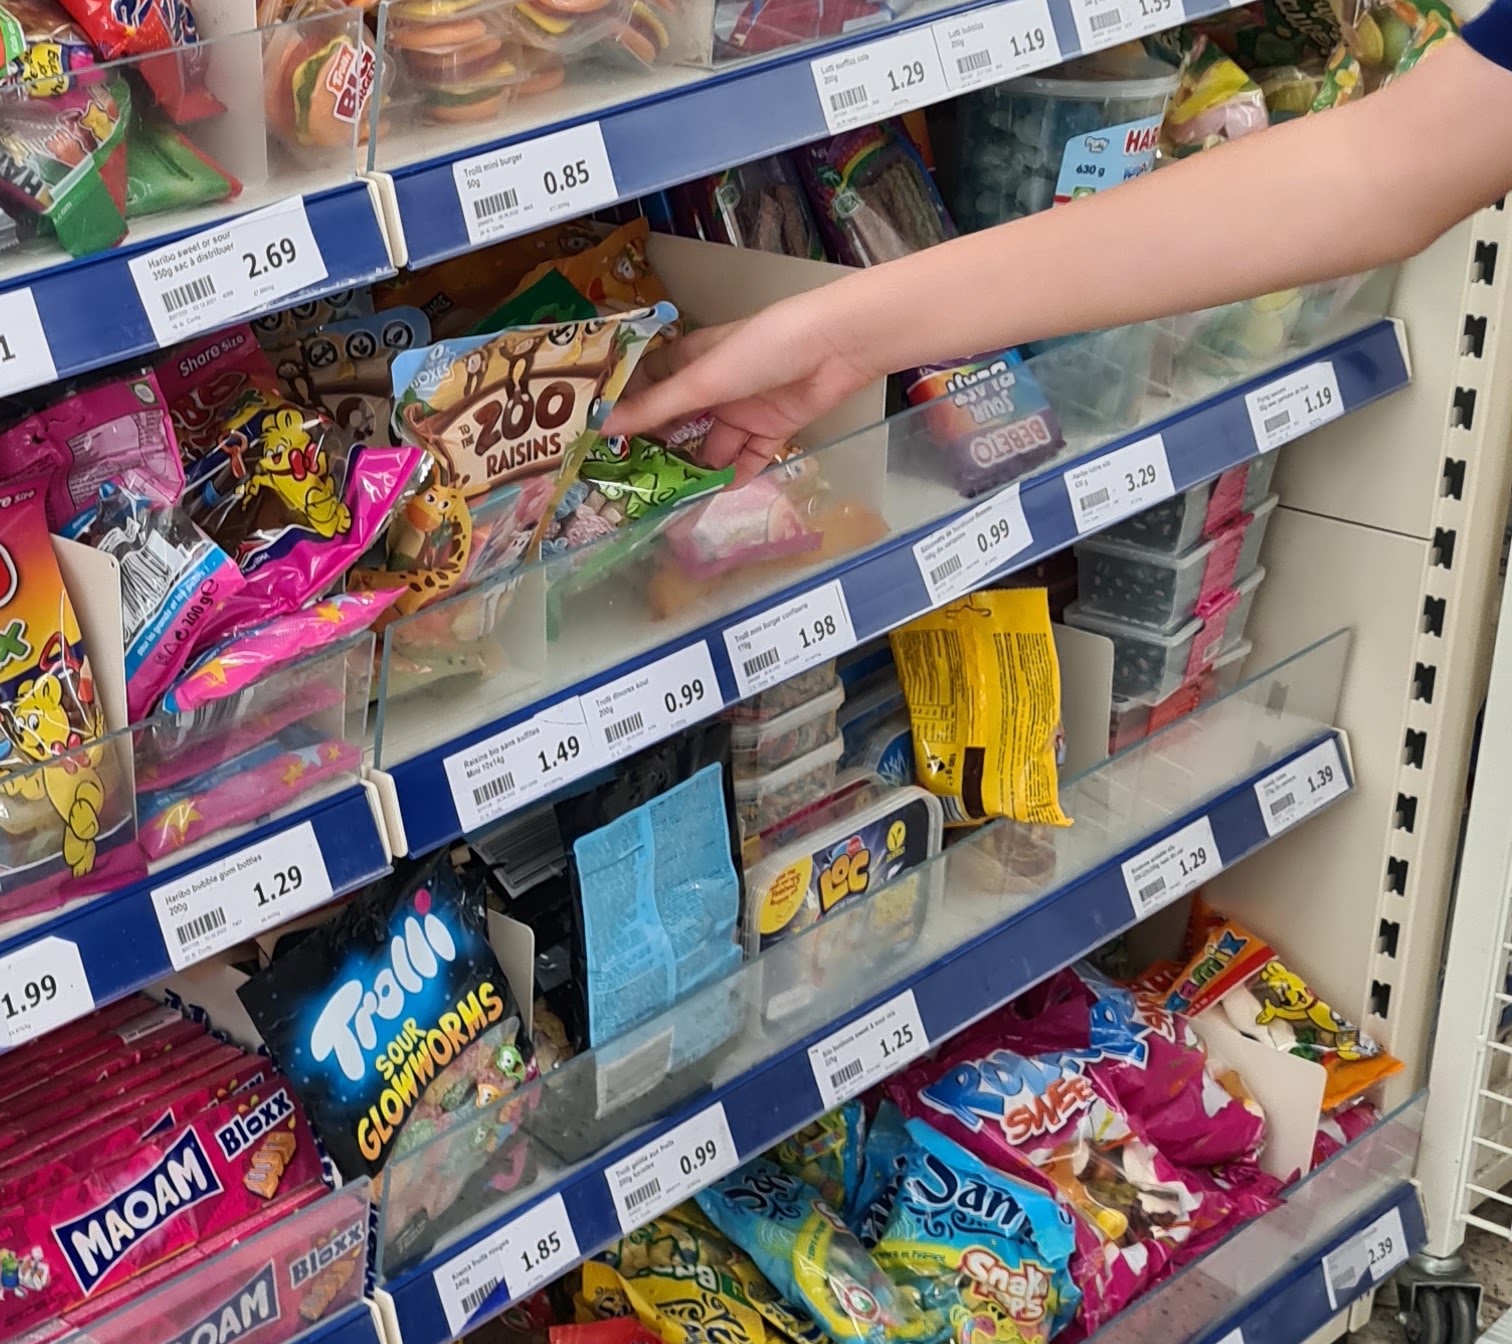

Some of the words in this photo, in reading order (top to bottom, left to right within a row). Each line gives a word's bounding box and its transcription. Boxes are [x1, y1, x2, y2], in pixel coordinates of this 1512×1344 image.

[1009, 28, 1046, 58] 1.19
[886, 60, 925, 93] 1.29
[500, 152, 523, 169] burger
[543, 159, 590, 196] 0.85
[1076, 163, 1096, 177] 630
[148, 252, 177, 270] Haribo
[197, 242, 236, 264] distribuer
[242, 236, 298, 280] 2.69
[177, 347, 221, 379] Share
[472, 378, 576, 456] ZOO
[1304, 386, 1333, 413] 1.19
[485, 431, 563, 480] RAISINS
[1124, 463, 1157, 492] 3.29
[976, 518, 1011, 554] 0.99
[798, 615, 837, 650] 1.98
[663, 678, 706, 713] 0.99
[538, 735, 581, 774] 1.49
[1307, 766, 1336, 794] 1.39
[1179, 846, 1208, 876] 1.29
[164, 885, 192, 906] Haribo
[192, 872, 219, 893] bubble
[252, 864, 303, 907] 1.29
[0, 973, 58, 1019] 1.99
[311, 886, 458, 1083] Trolli
[375, 1017, 427, 1080] SOUR
[879, 1023, 914, 1058] 1.25
[357, 980, 505, 1161] GLOWWORMS
[679, 1138, 718, 1176] 0.99
[73, 1144, 210, 1278] MAOAM
[219, 1090, 294, 1162] Bloxx
[289, 1218, 367, 1289] Bloxx
[520, 1230, 562, 1273] 1.85
[1368, 1235, 1393, 1266] 2.39
